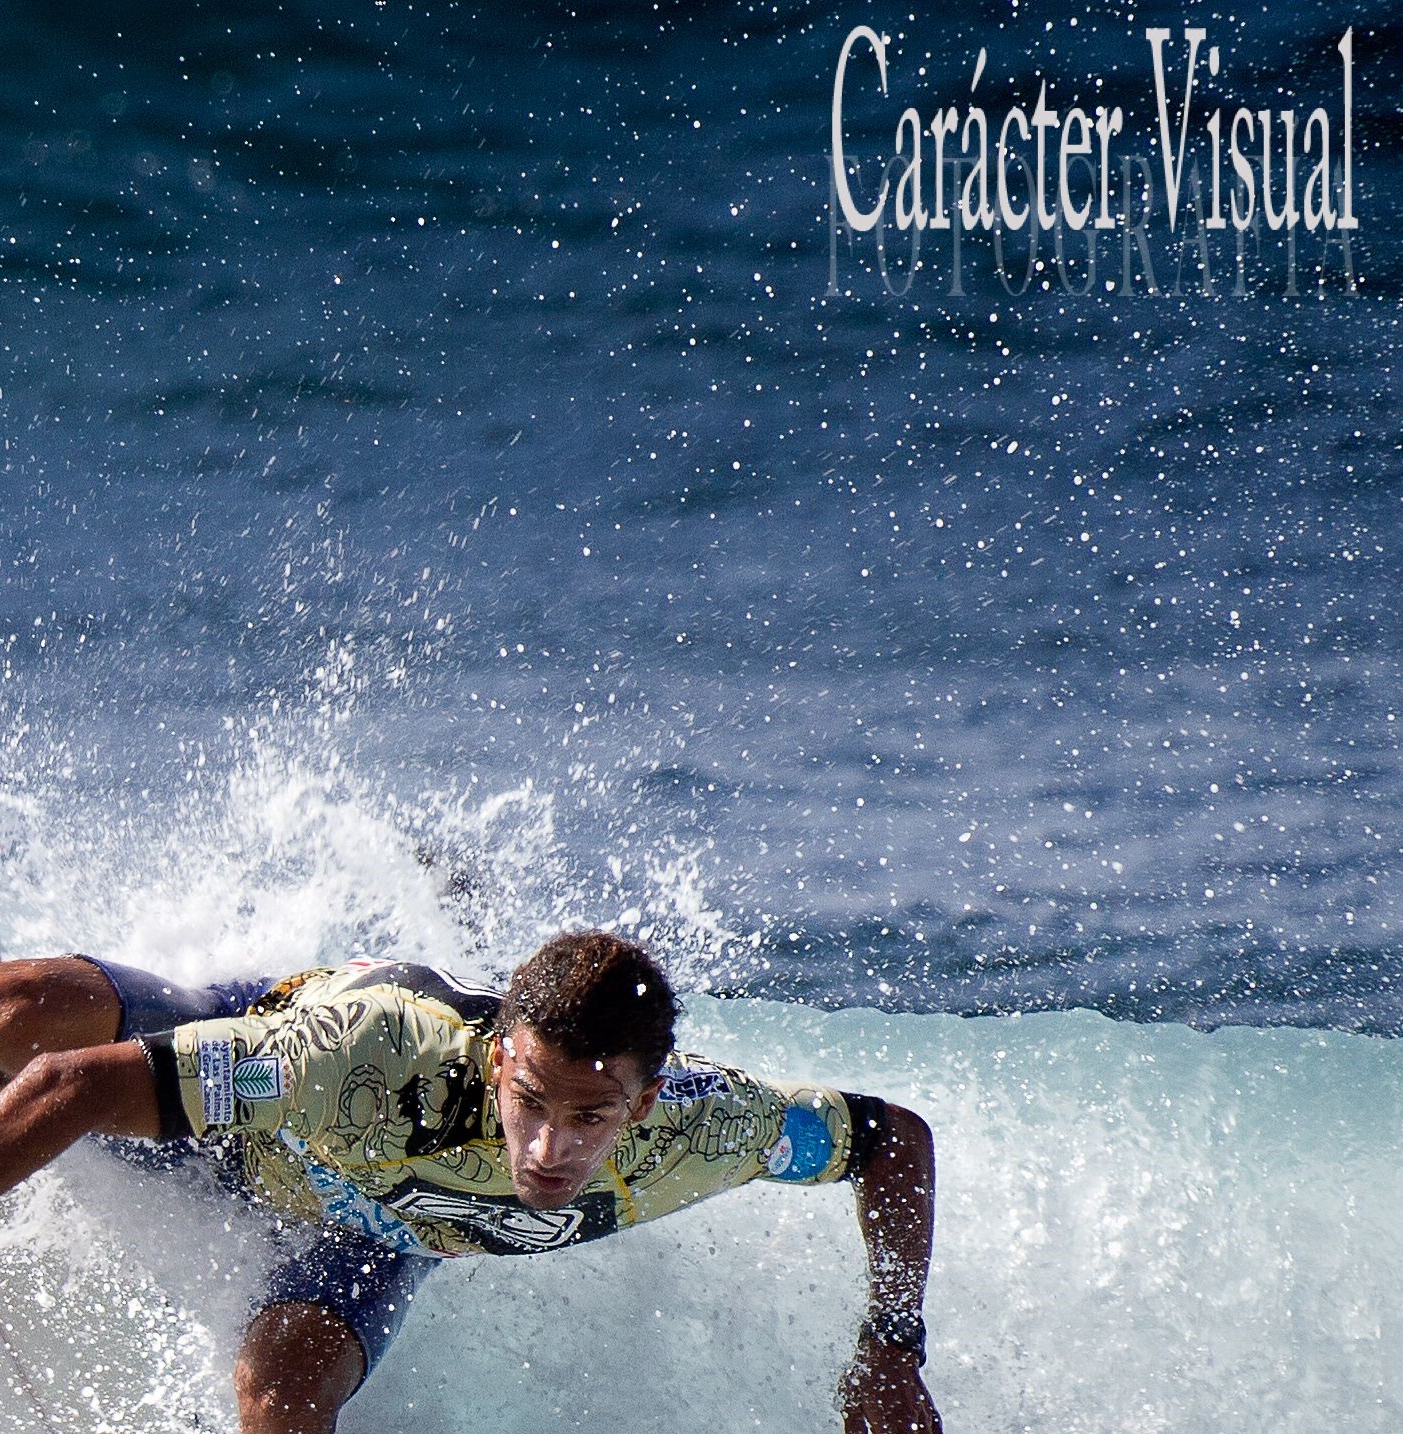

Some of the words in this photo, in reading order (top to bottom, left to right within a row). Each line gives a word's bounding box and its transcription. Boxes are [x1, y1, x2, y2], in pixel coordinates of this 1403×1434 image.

[203, 1054, 211, 1080] Gran
[221, 1040, 232, 1122] Ayuntamiento
[203, 1085, 212, 1122] Canaria
[214, 1083, 222, 1122] Palmas
